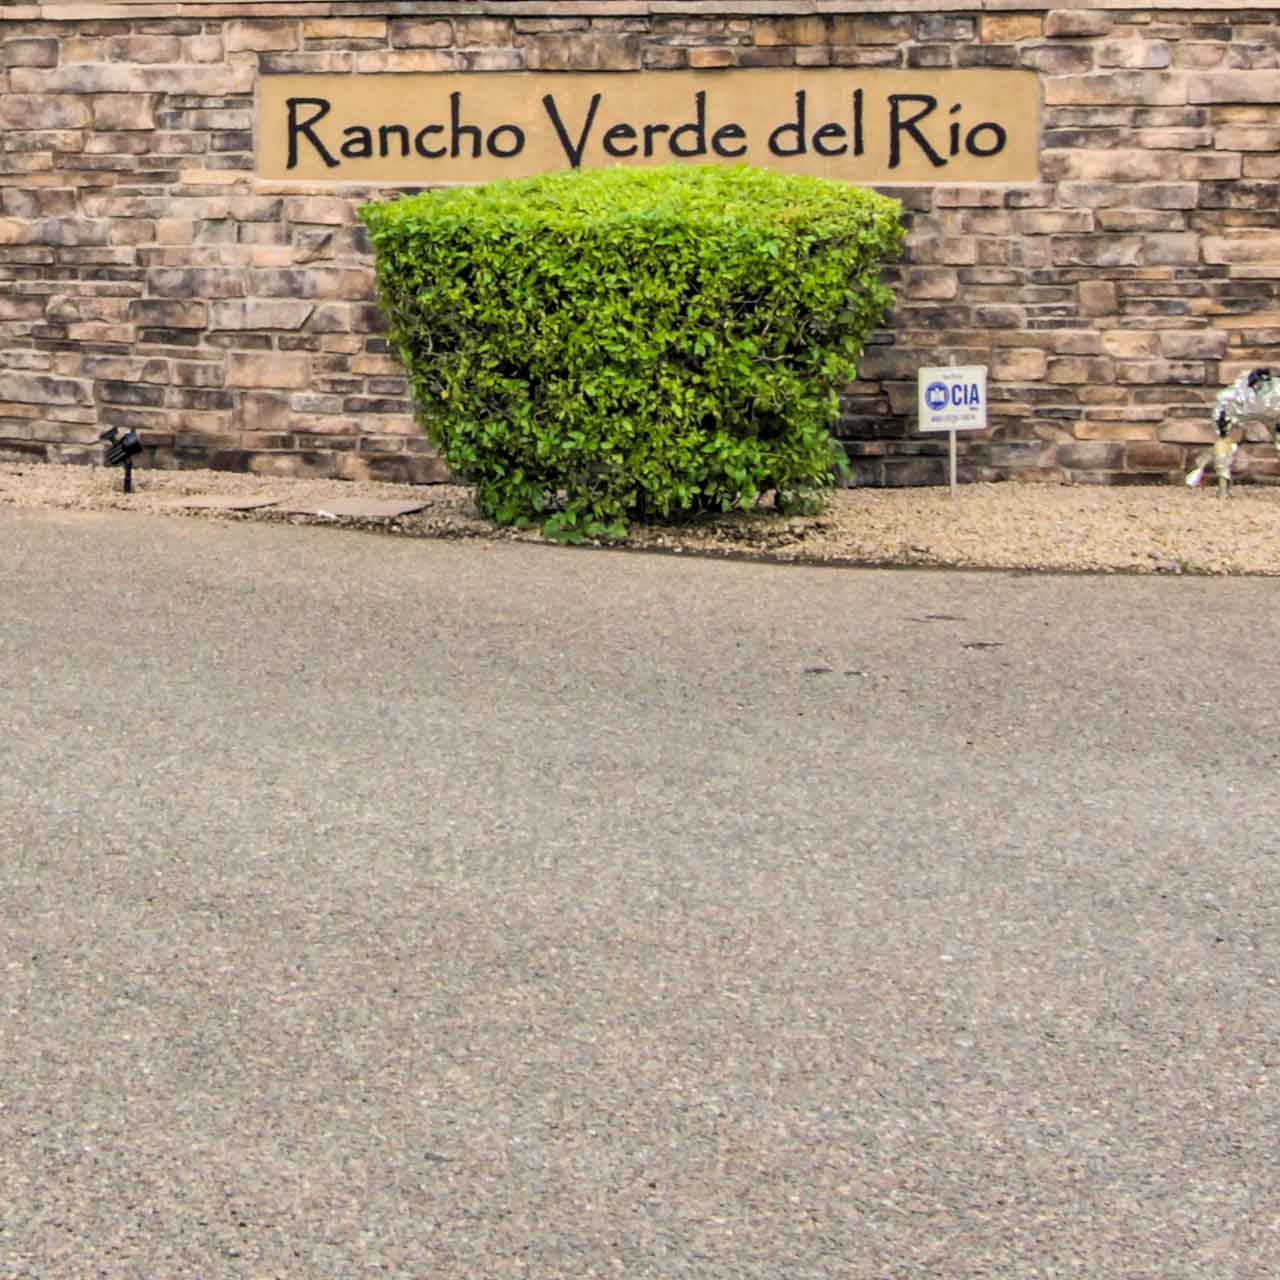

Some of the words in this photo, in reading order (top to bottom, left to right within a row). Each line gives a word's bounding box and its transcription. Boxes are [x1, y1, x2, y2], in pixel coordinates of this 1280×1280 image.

[286, 91, 525, 170] Rancho
[542, 91, 748, 169] Verde
[768, 88, 864, 157] del
[887, 94, 1007, 169] Río
[951, 383, 980, 406] CIA
